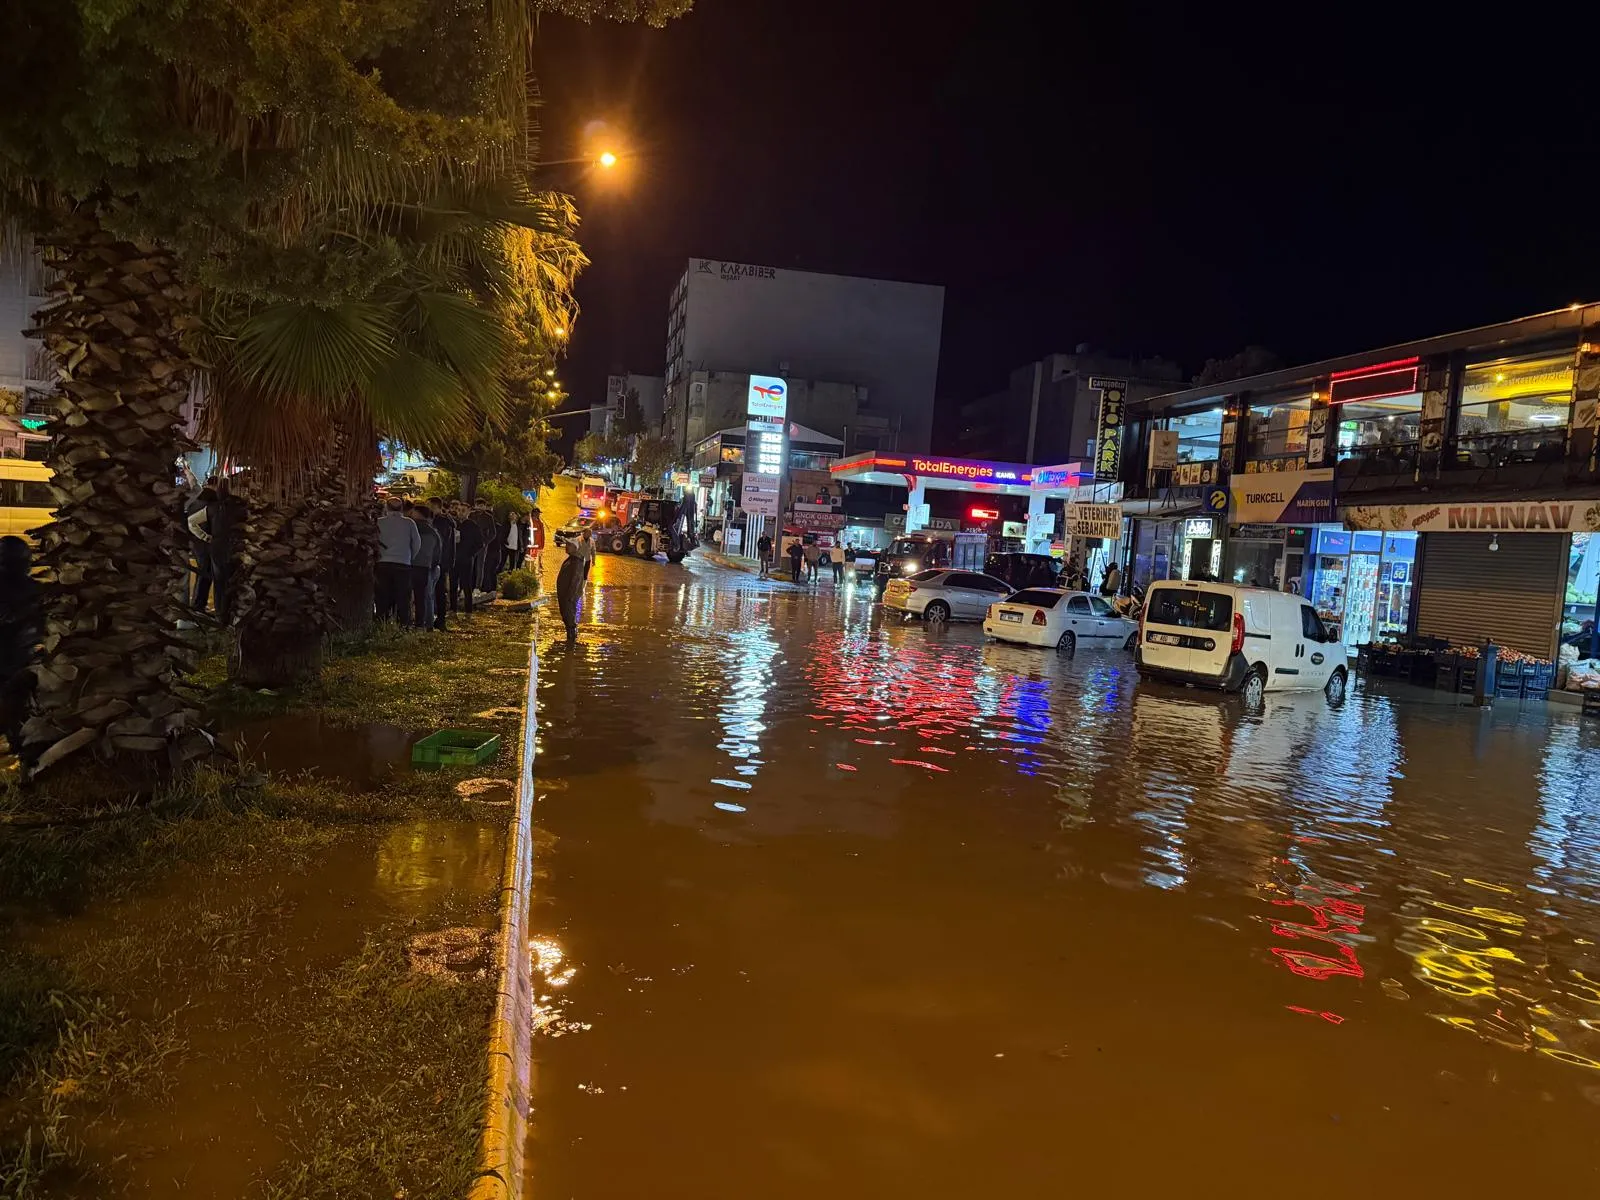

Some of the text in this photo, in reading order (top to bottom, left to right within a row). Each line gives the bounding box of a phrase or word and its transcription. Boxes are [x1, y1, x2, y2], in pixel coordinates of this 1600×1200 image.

[912, 459, 993, 478] TotalEnergies
[1246, 492, 1285, 503] TURKCELL
[1316, 499, 1330, 507] GSM
[1448, 504, 1574, 529] MANAV
